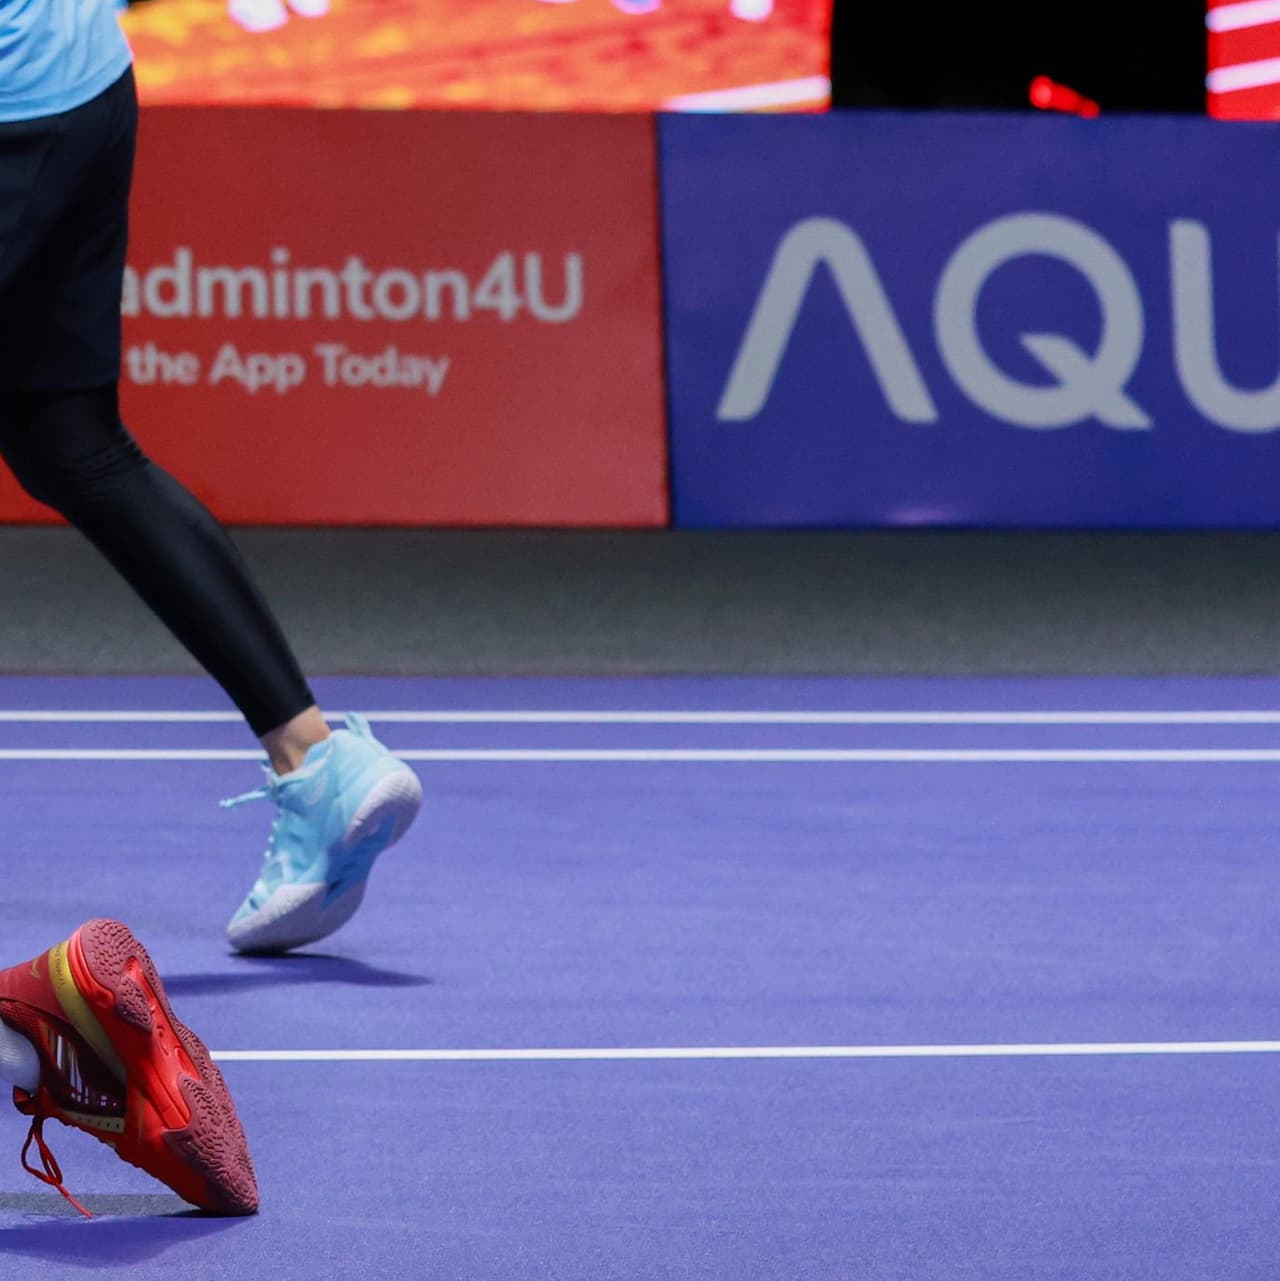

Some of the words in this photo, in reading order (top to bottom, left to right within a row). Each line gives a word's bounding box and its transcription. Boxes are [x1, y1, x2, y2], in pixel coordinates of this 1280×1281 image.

[127, 342, 201, 385] the
[209, 342, 305, 397] App
[315, 343, 451, 397] Today
